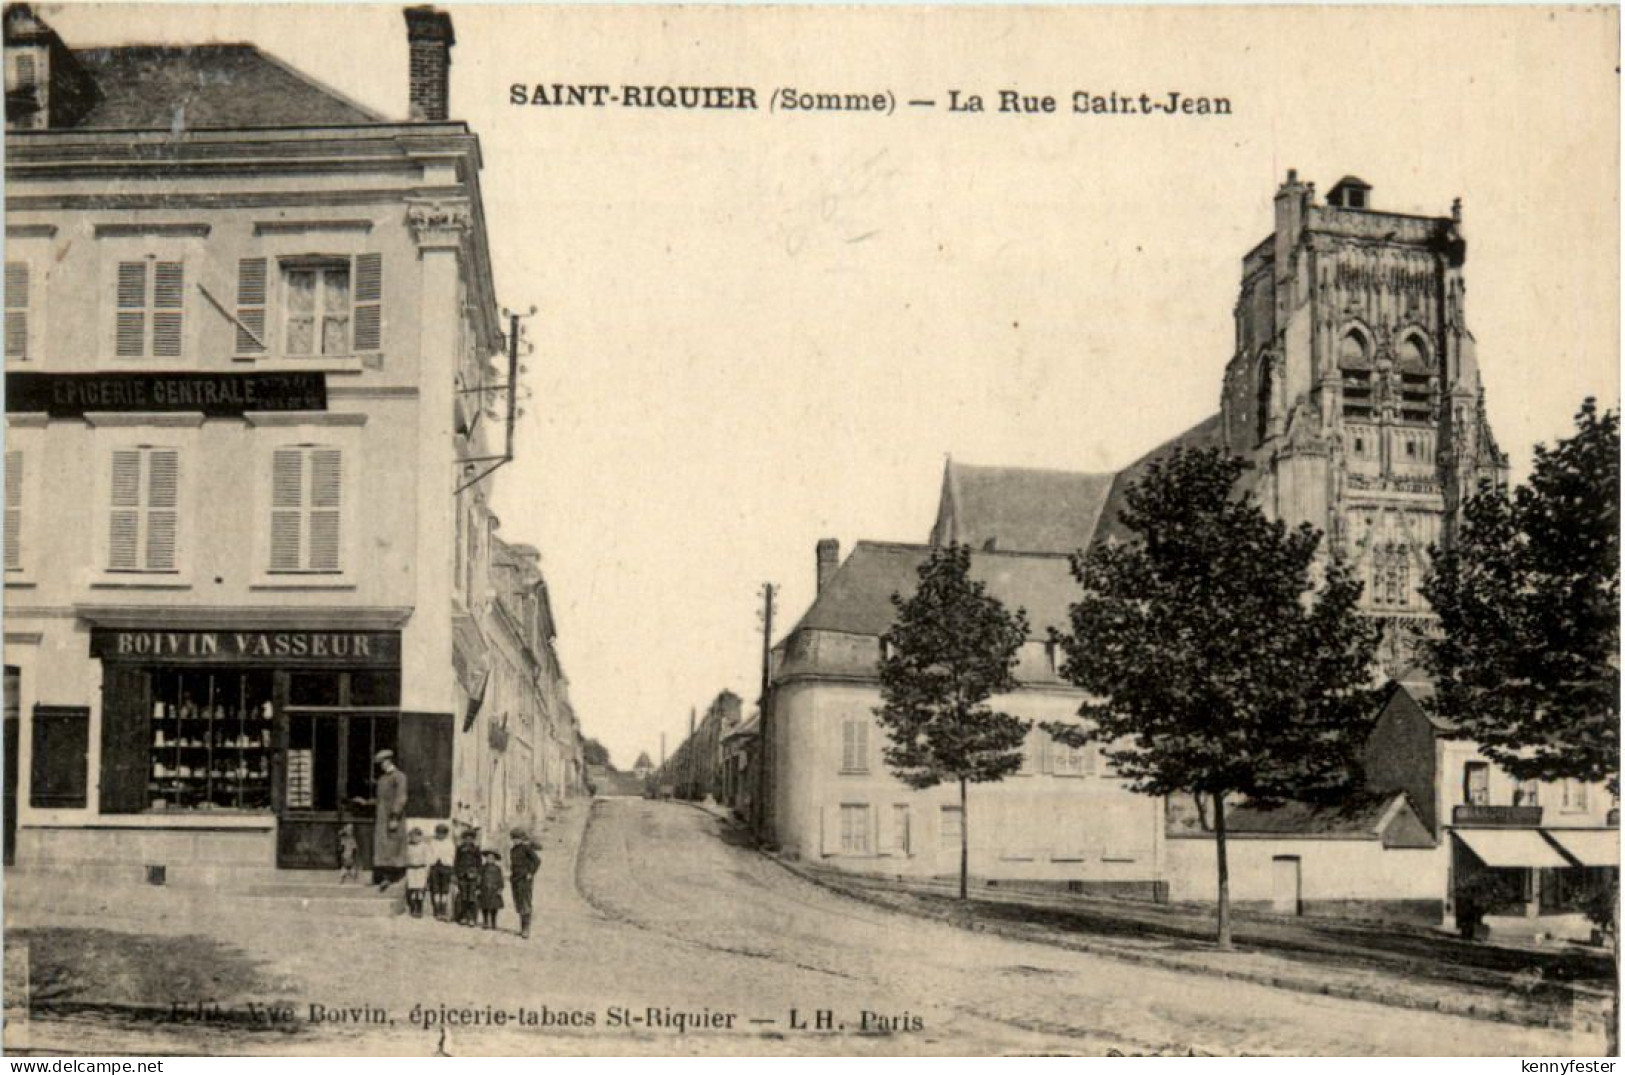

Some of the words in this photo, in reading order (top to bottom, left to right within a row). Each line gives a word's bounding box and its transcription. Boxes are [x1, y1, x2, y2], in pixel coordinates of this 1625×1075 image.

[153, 379, 256, 404] CENTRALE
[117, 632, 218, 655] BOIVIN
[235, 633, 371, 657] VASSEUR
